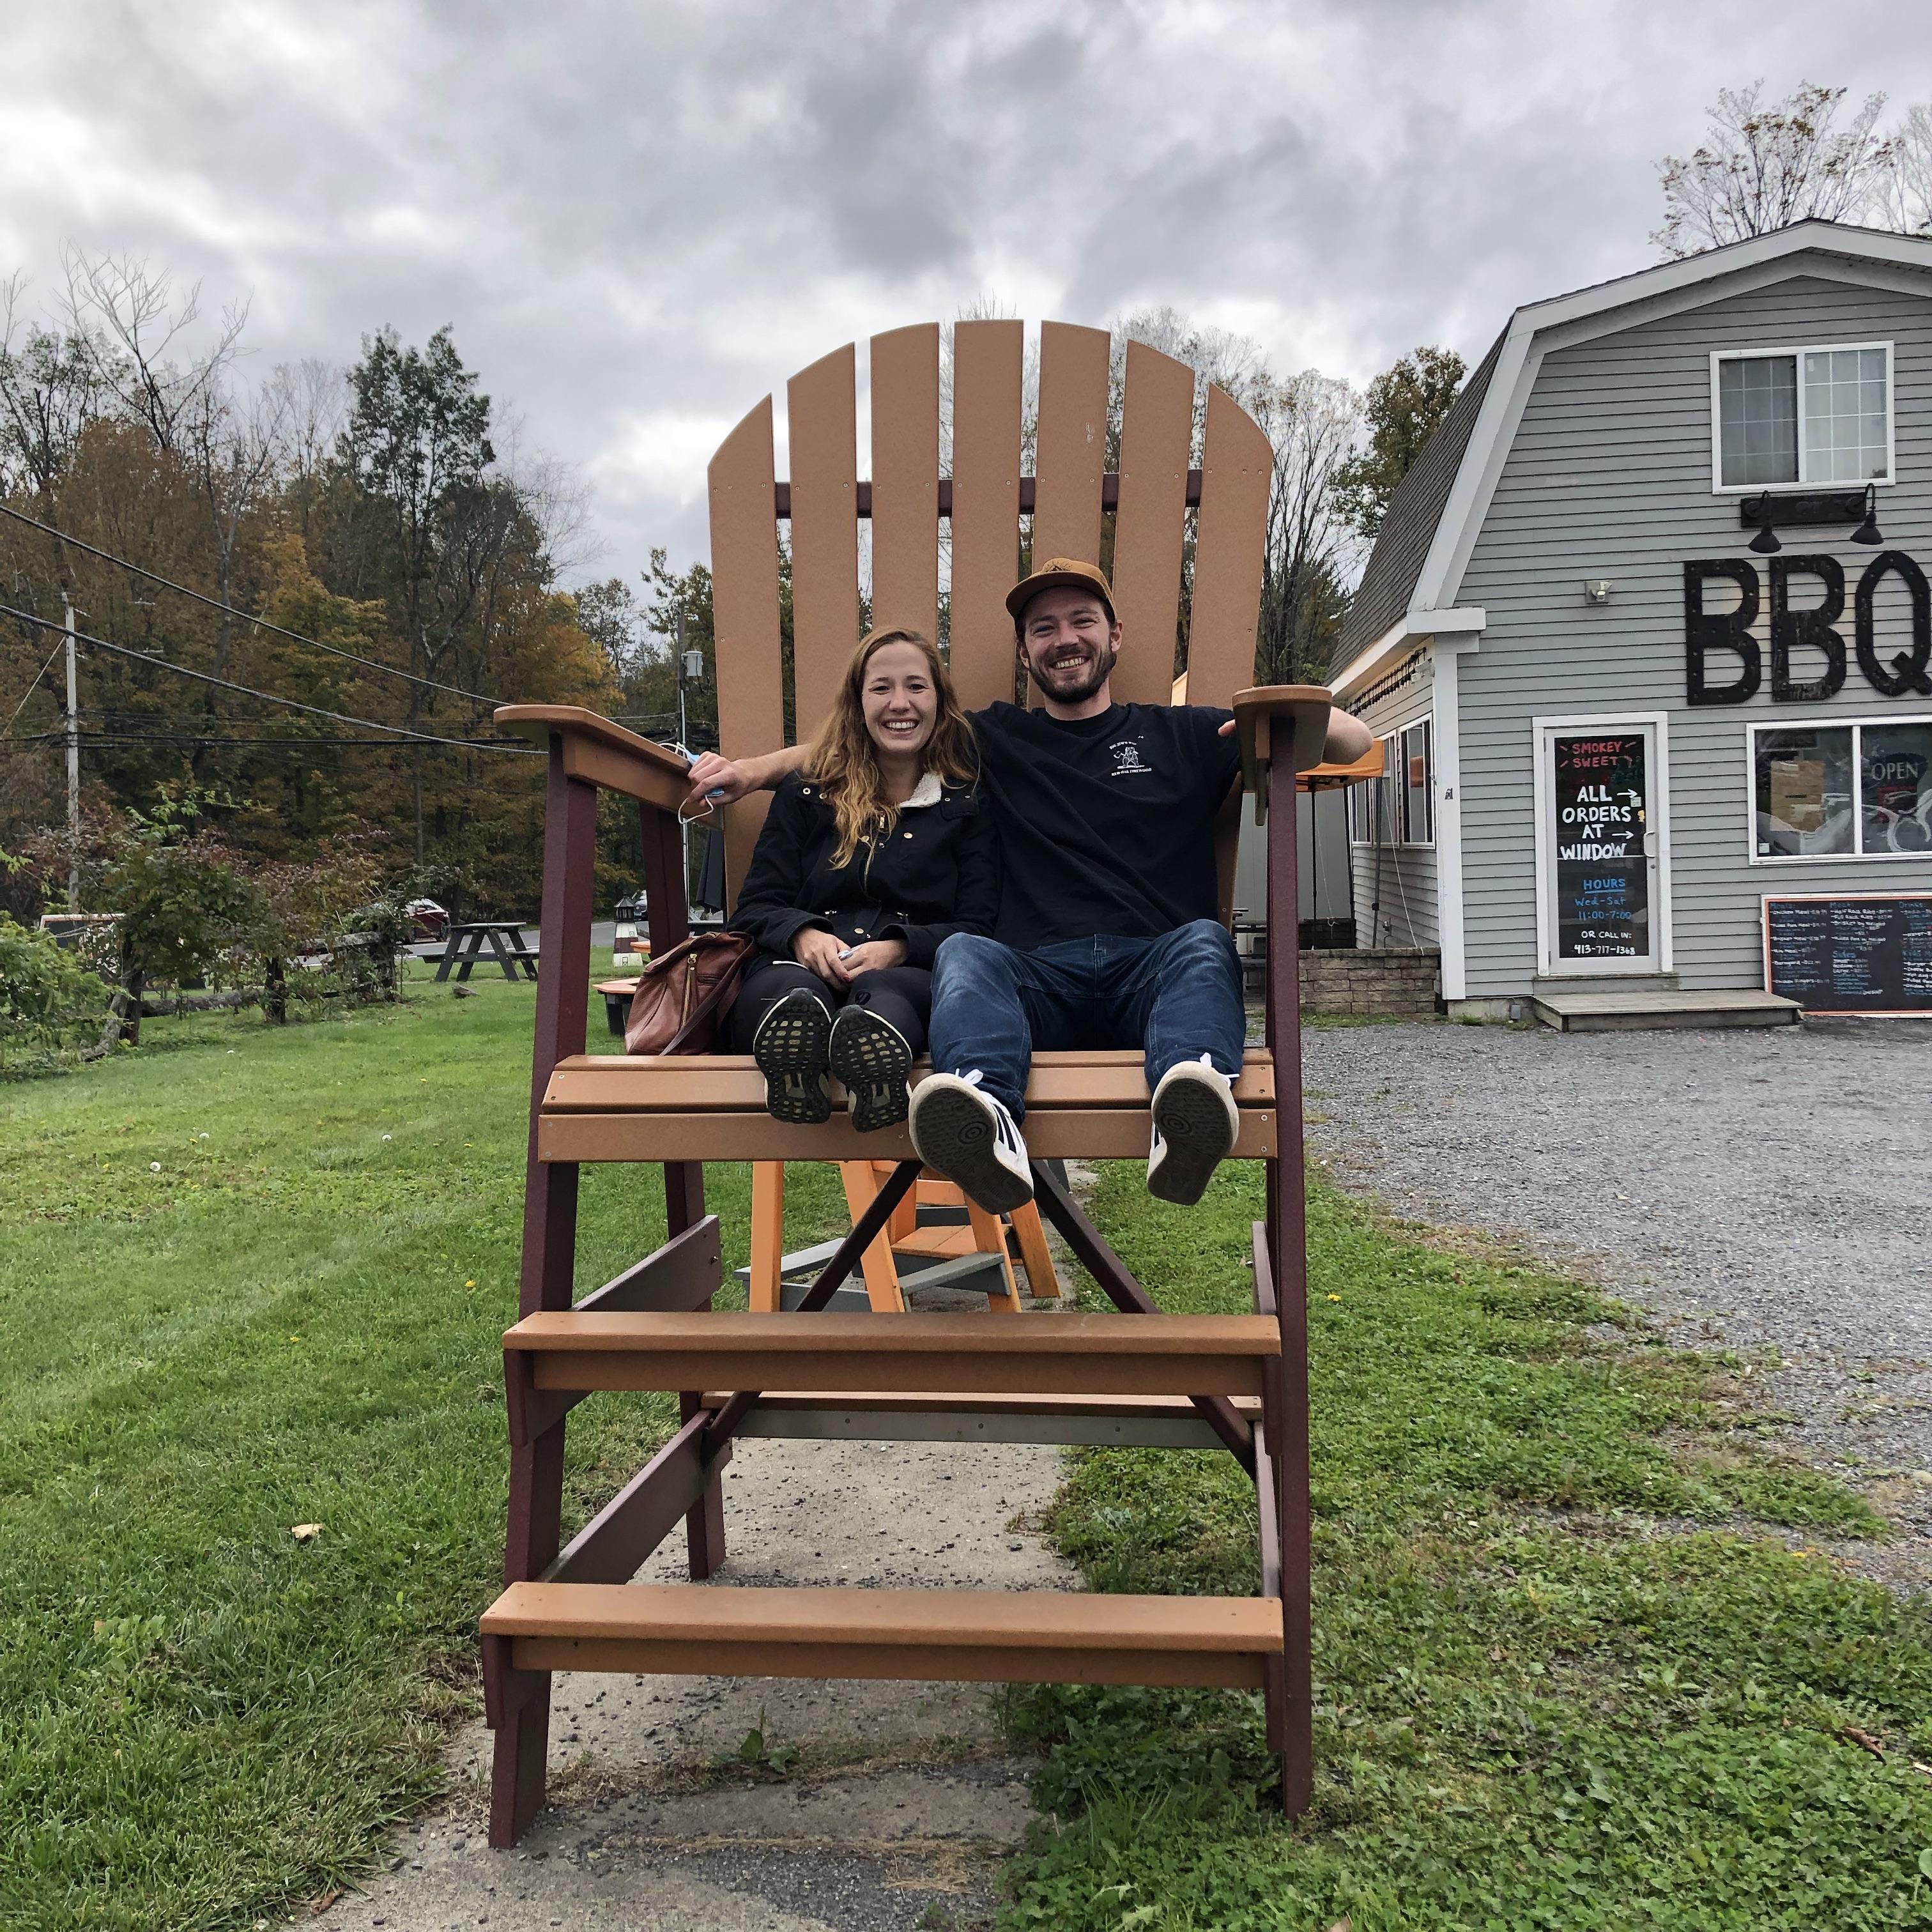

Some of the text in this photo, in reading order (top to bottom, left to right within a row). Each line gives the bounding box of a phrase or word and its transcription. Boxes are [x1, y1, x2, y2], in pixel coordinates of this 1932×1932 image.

[1684, 550, 1931, 705] BBQ
[1572, 741, 1622, 755] SMOKEY
[1572, 756, 1618, 768] SWEET
[1871, 762, 1919, 781] OPEN
[1577, 785, 1613, 802] ALL
[1562, 806, 1631, 823] ORDERS
[1582, 824, 1604, 839] AT
[1560, 842, 1627, 861] WINDOW
[1583, 878, 1625, 890] HOURS
